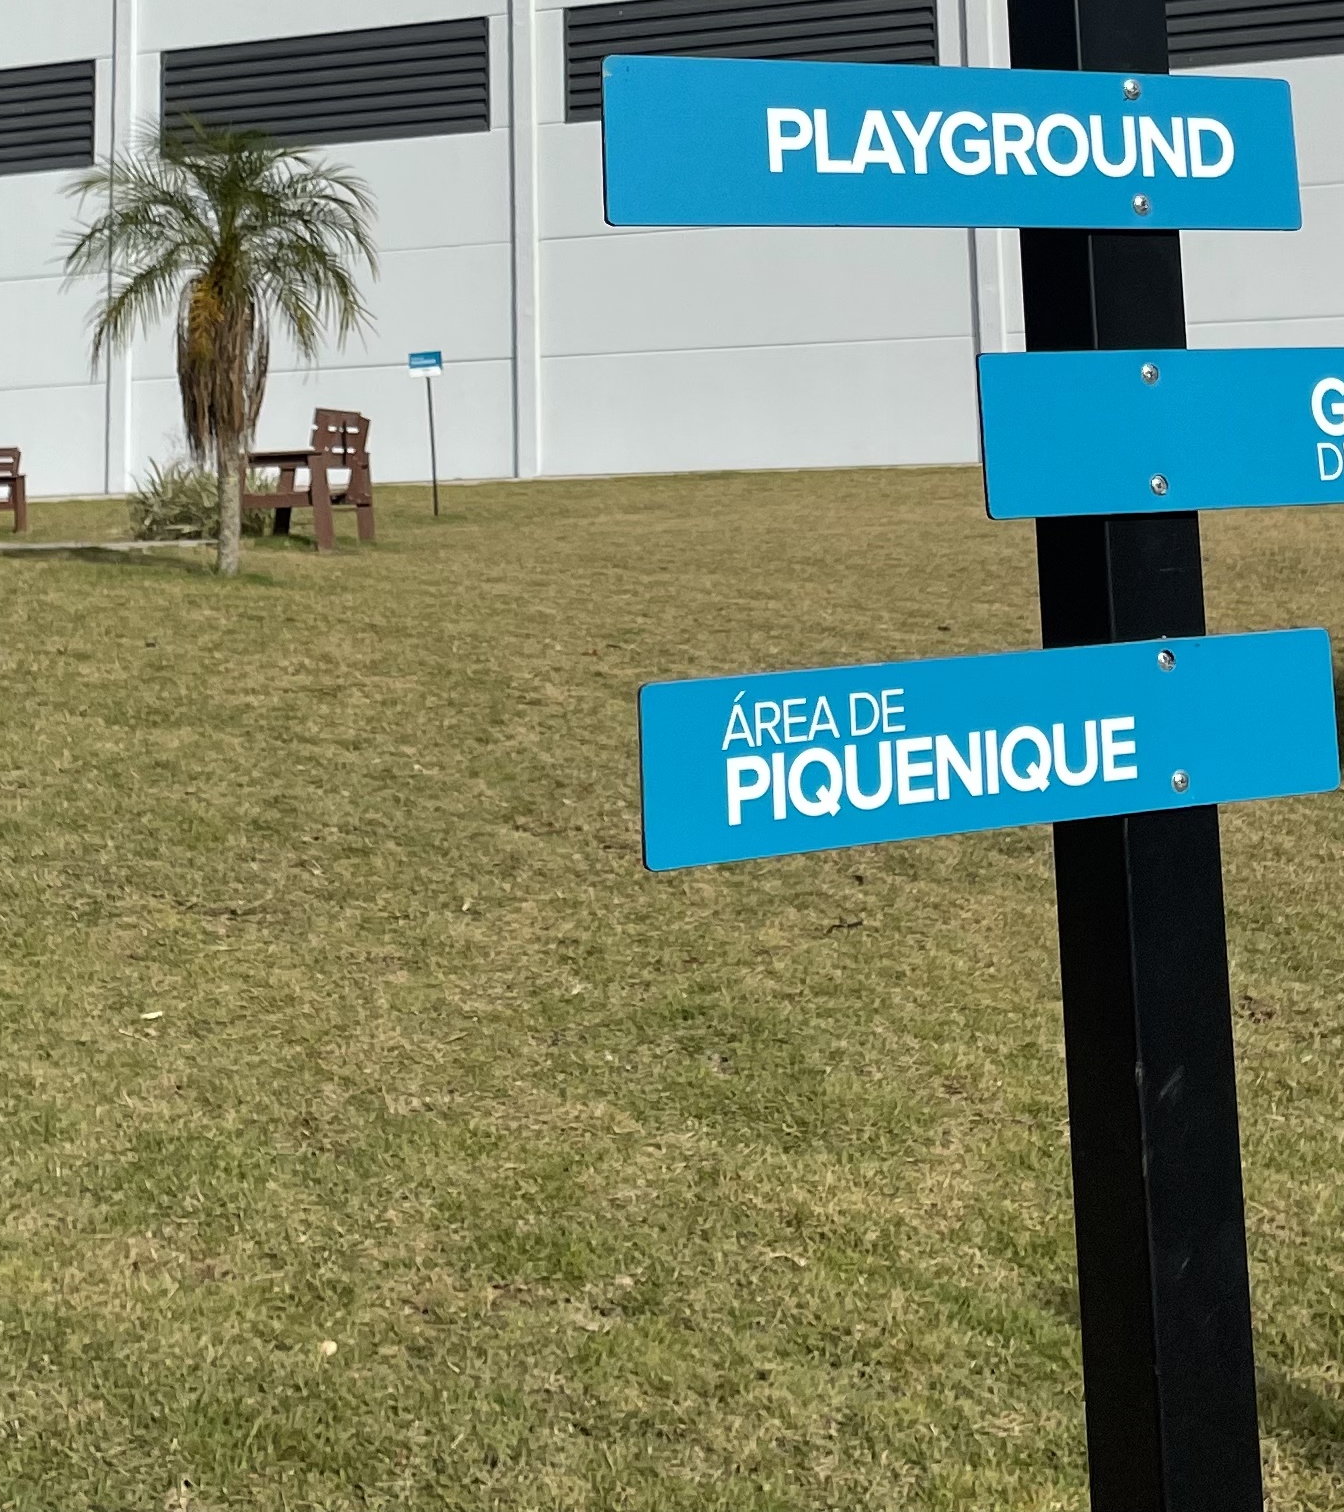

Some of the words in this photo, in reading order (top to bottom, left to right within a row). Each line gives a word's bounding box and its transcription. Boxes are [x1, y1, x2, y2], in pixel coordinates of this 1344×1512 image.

[766, 107, 1235, 178] PLAYGROUND
[721, 691, 841, 751] ÁREA
[849, 687, 906, 737] DE
[725, 716, 1138, 827] PIQUENIQUE
